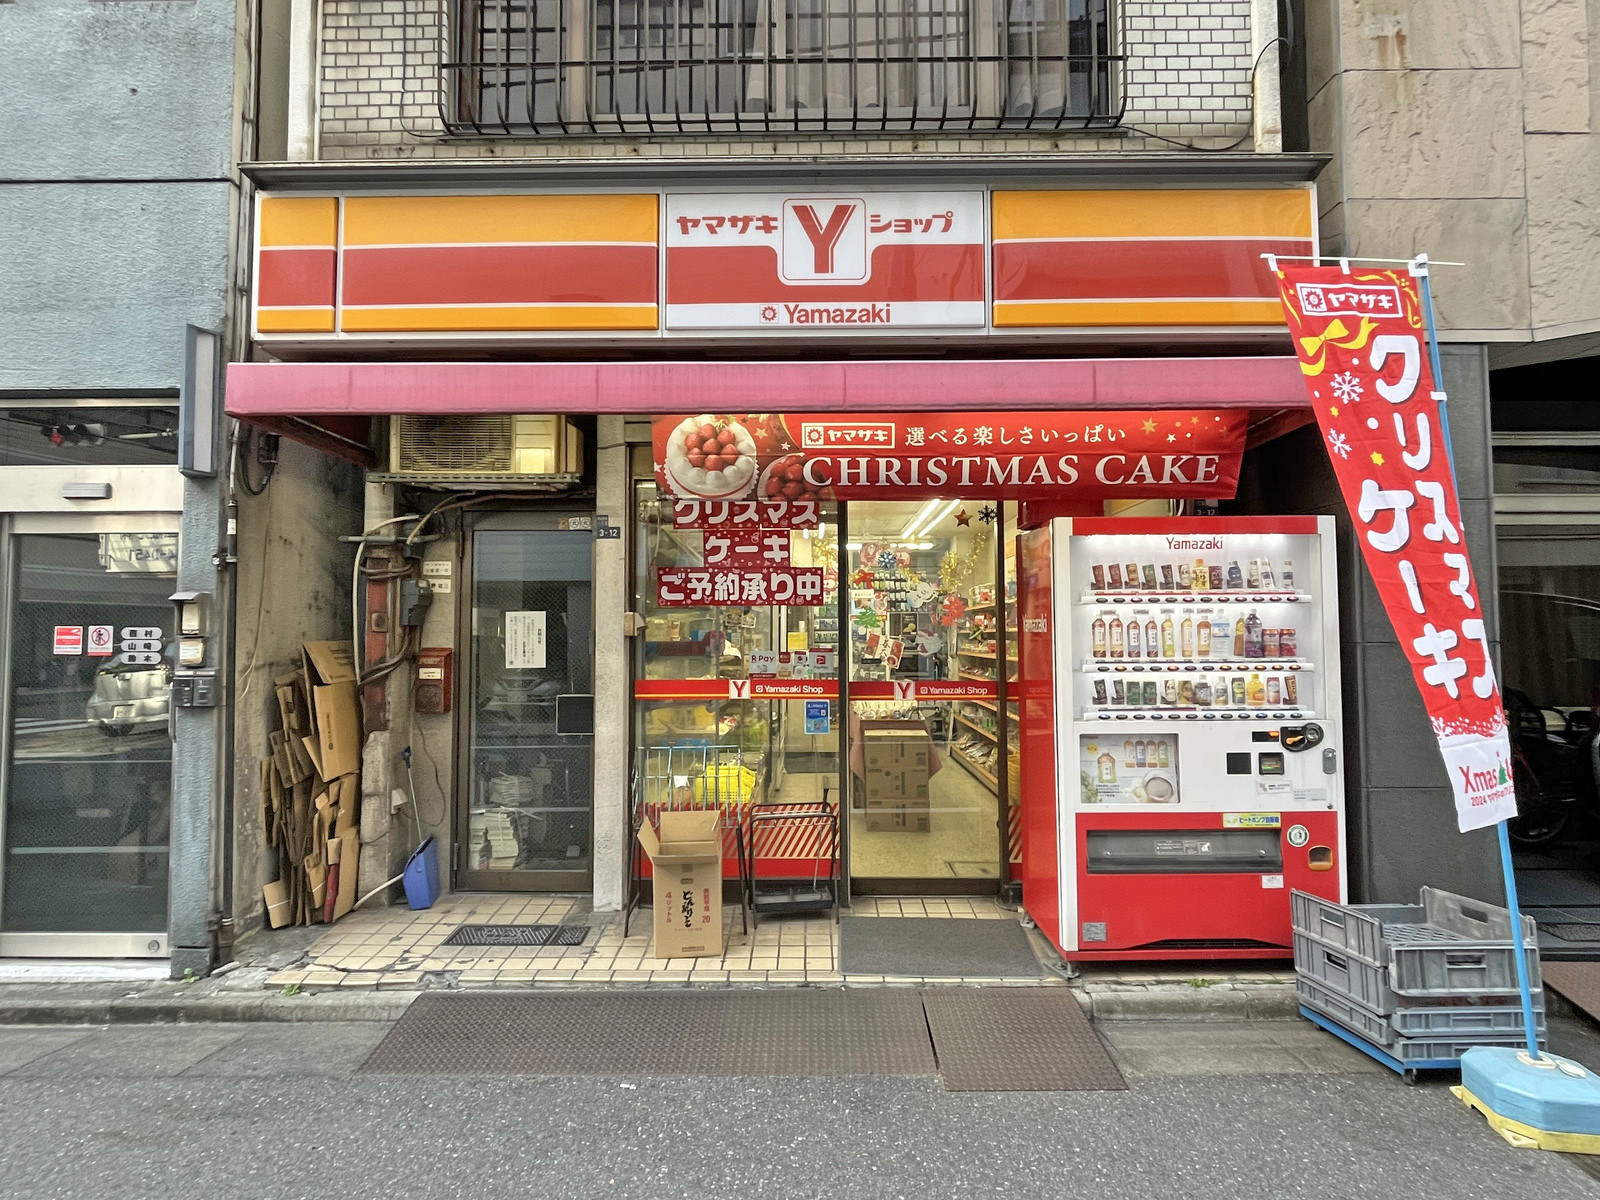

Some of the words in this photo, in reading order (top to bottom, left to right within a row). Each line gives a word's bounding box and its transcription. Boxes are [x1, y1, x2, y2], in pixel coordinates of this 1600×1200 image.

[677, 215, 778, 234] ヤマザキ
[791, 204, 857, 274] Y
[870, 210, 954, 233] ショップ
[1328, 292, 1393, 309] ヤマザキ
[784, 303, 891, 324] Yamazaki
[827, 429, 888, 442] ヤマザキ
[905, 424, 1126, 448] 選べる楽しさいっぱい
[803, 455, 1079, 486] CHRISTMAS
[1095, 455, 1220, 485] CAKE
[675, 501, 818, 525] クリスマス
[599, 529, 617, 537] 3-12
[1166, 537, 1224, 550] Yamazaki
[705, 535, 789, 563] ケーキ
[660, 572, 821, 601] ご予約承り中
[1358, 479, 1467, 699] ケーキ
[758, 655, 775, 663] Pay
[732, 681, 748, 698] Y
[764, 685, 801, 693] Yamazaki
[802, 685, 824, 695] Shop
[896, 682, 913, 699] Y
[929, 686, 966, 694] Yamazaki
[966, 686, 988, 696] Shop
[1458, 765, 1498, 794] Xmas
[1471, 795, 1488, 806] 2024
